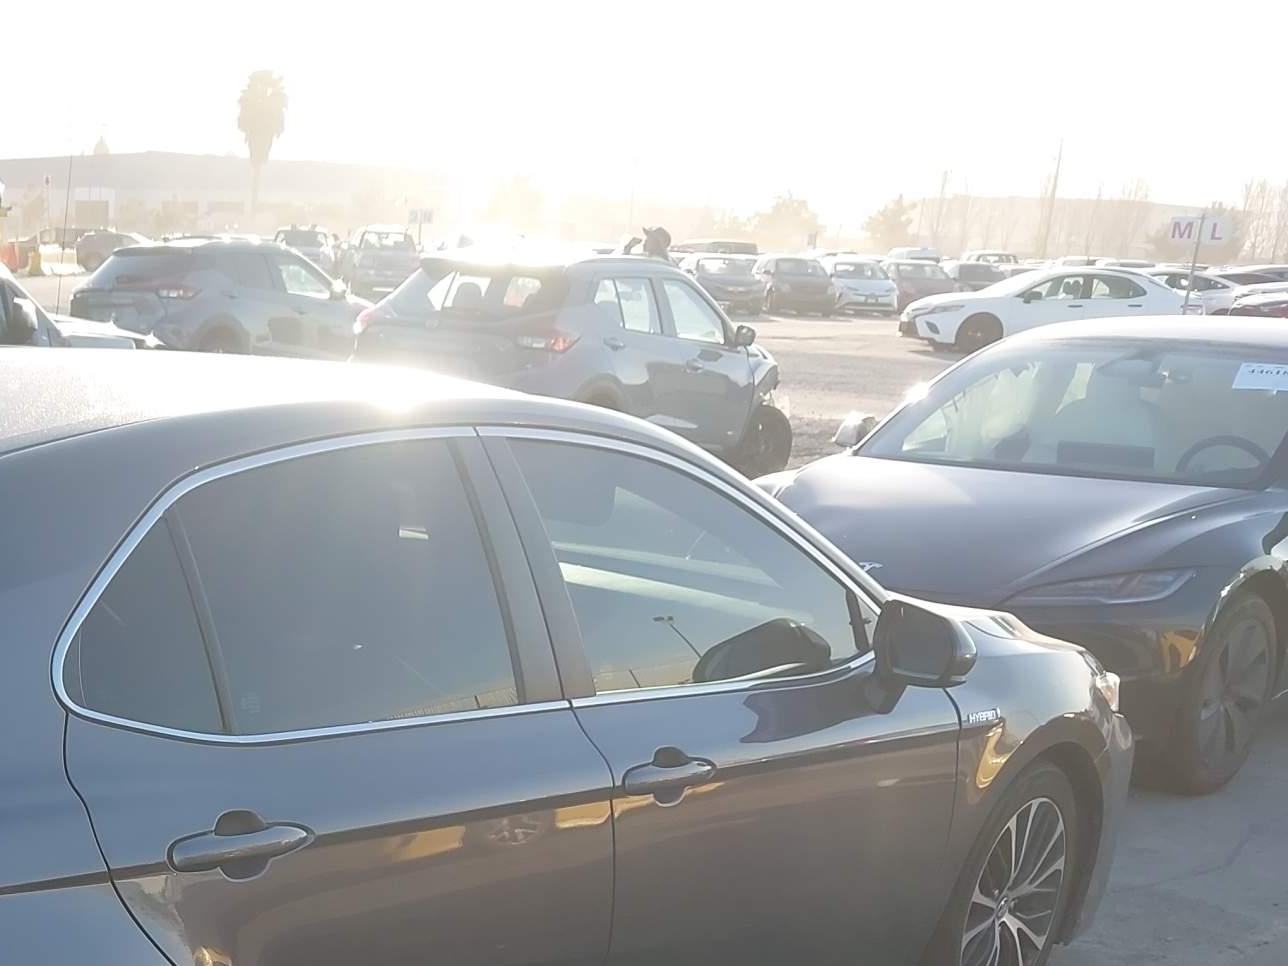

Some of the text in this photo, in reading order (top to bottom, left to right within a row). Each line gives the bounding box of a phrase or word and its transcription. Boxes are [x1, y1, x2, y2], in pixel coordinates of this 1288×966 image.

[1171, 221, 1193, 239] M
[1211, 222, 1223, 240] L
[969, 710, 996, 723] HYBRID
